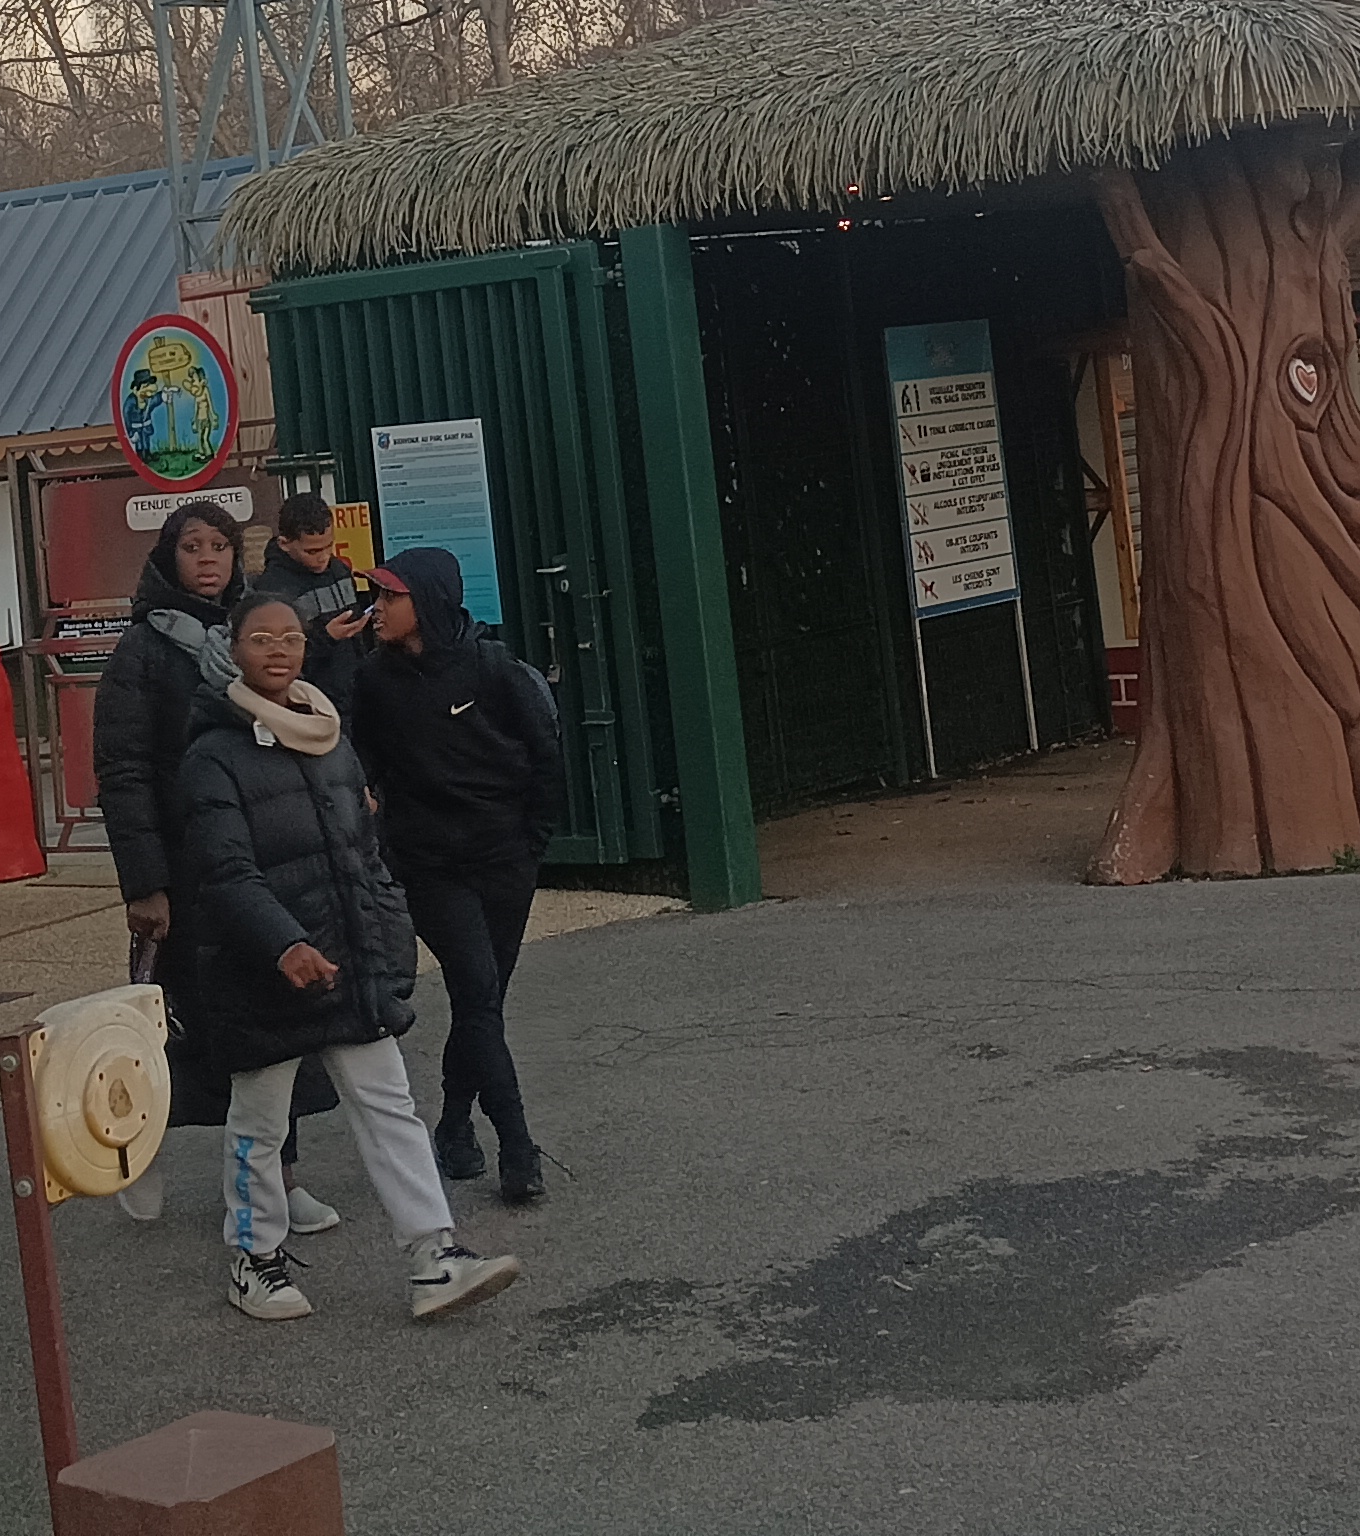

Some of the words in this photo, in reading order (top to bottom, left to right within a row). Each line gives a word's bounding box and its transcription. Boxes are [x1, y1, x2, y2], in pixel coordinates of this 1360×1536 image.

[930, 396, 942, 405] VOS
[944, 393, 959, 403] SACS
[961, 391, 986, 401] OUVERTS
[444, 433, 459, 441] SAINT
[929, 426, 946, 436] TENUE
[973, 455, 985, 464] SUR
[986, 454, 996, 463] LES
[932, 467, 974, 481] INSTALLATIONS
[958, 477, 969, 486] CET
[971, 474, 986, 484] EFFET
[133, 499, 171, 511] TENUE
[933, 498, 957, 510] ALCOOLS
[959, 497, 966, 506] ET
[956, 504, 985, 516] INTERDITS
[945, 536, 967, 547] OBJETS
[969, 530, 998, 543] COUPANTS
[960, 542, 988, 554] INTERDITS
[952, 574, 962, 584] LES
[964, 570, 984, 582] CHIENS
[986, 566, 1000, 577] SONT
[963, 578, 992, 591] INTERDITS
